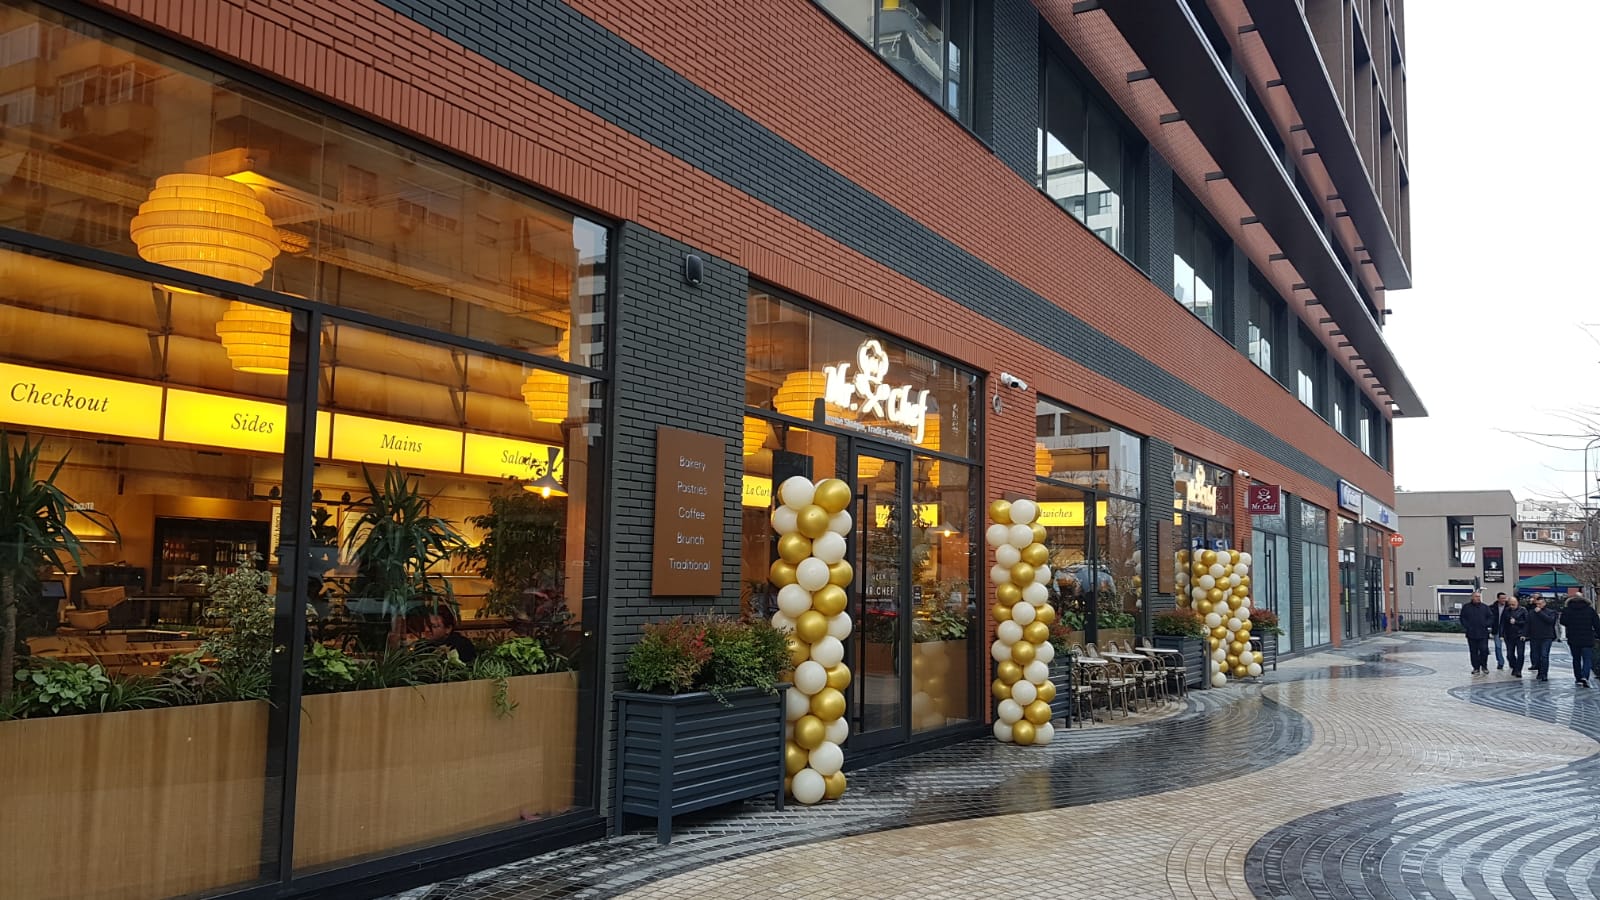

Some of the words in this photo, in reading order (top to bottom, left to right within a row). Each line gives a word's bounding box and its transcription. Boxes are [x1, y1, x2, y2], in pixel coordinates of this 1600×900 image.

[10, 382, 110, 412] Checkout
[886, 384, 930, 444] Chef
[230, 413, 275, 434] Sides
[380, 434, 423, 453] Mains
[501, 450, 537, 466] Salad
[679, 455, 706, 472] Bakery
[677, 481, 708, 495] Pastries
[678, 506, 705, 520] Coffee
[1262, 502, 1277, 511] Chef
[676, 532, 704, 545] Brunch
[668, 557, 711, 571] Traditional
